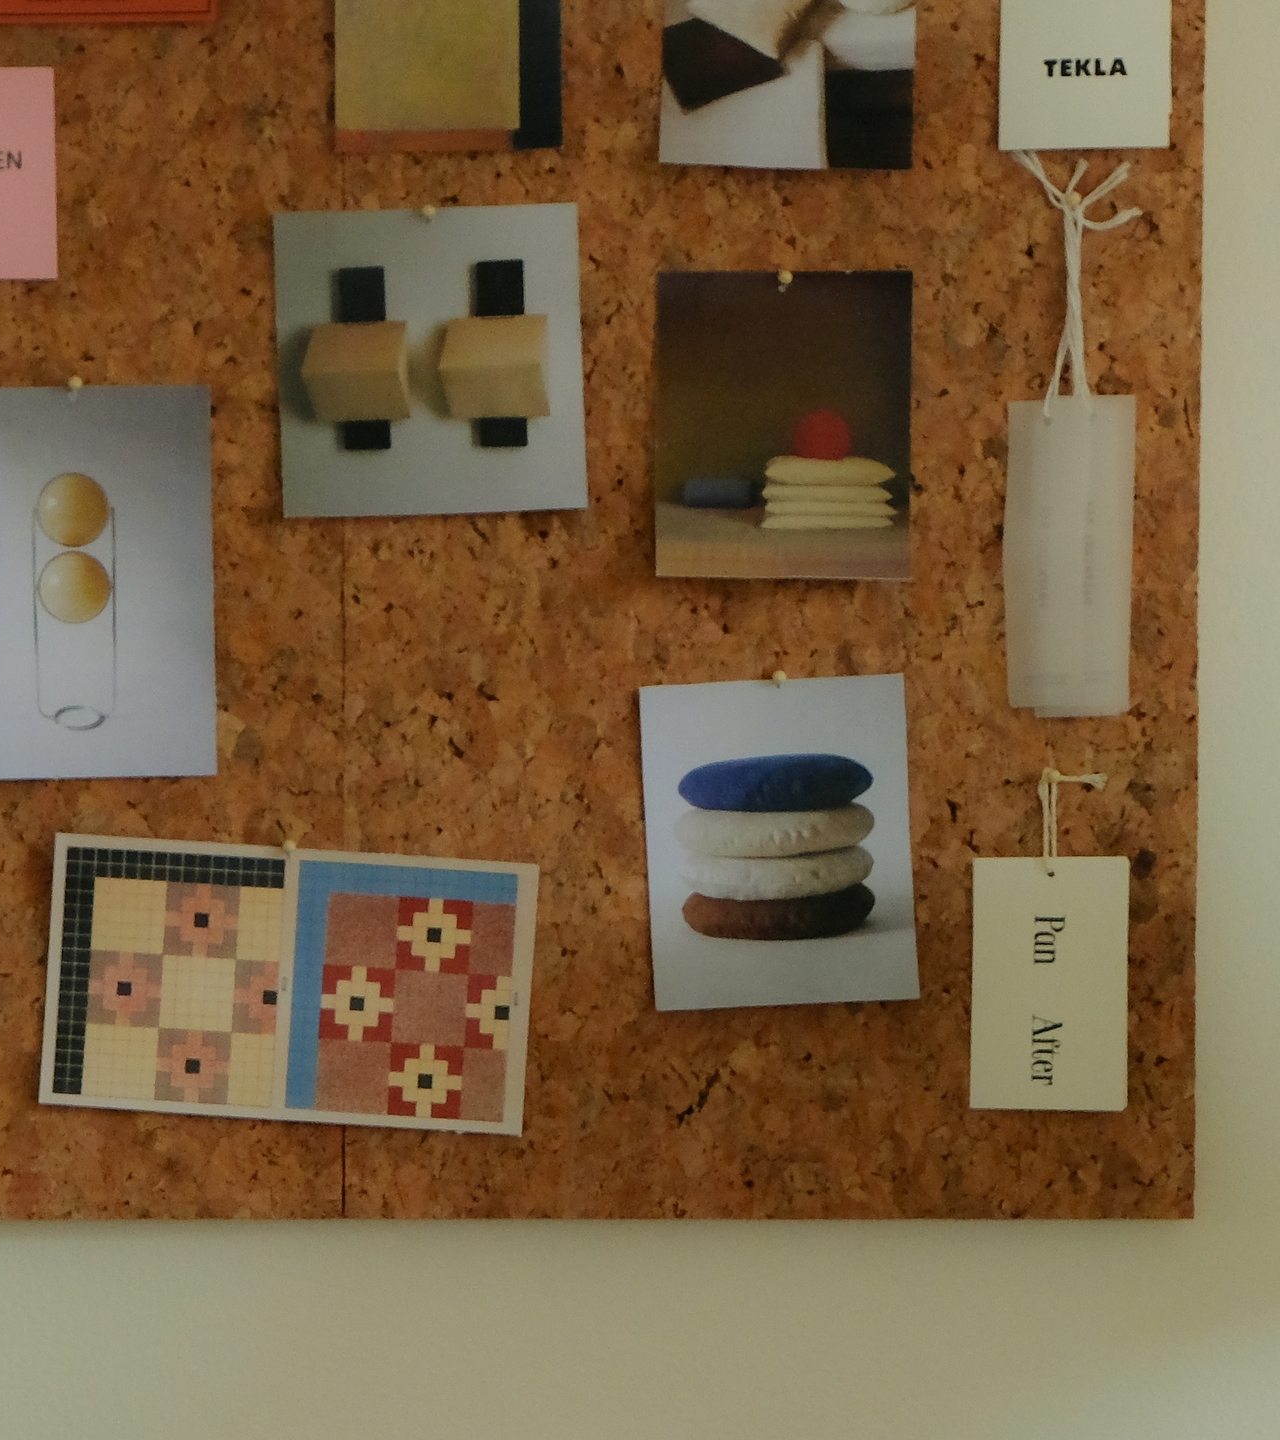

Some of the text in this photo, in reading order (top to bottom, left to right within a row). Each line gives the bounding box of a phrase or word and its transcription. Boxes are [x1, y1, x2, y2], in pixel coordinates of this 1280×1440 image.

[1043, 57, 1128, 78] TEKLA
[1029, 914, 1068, 1087] Pan After
